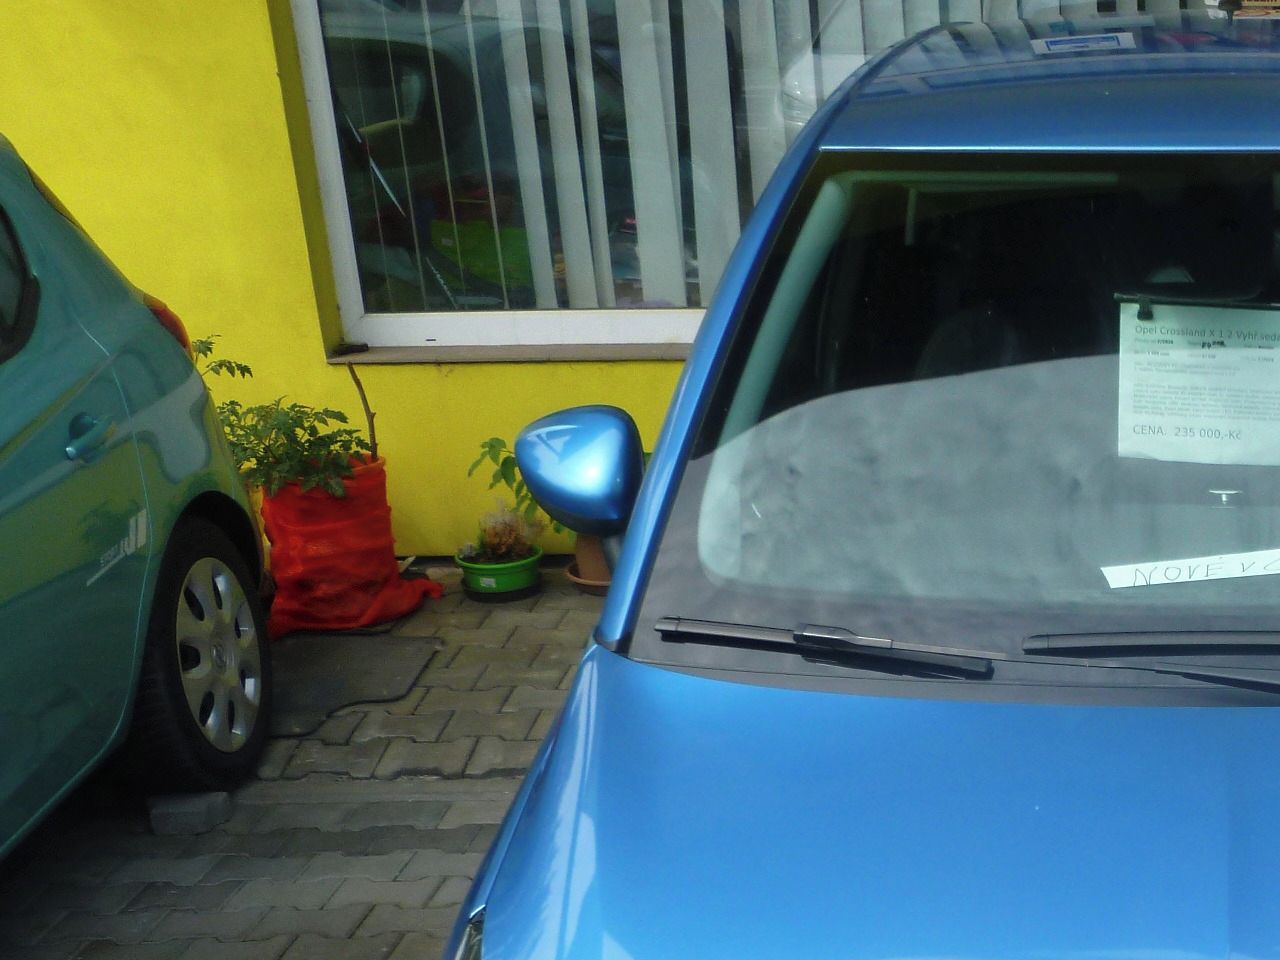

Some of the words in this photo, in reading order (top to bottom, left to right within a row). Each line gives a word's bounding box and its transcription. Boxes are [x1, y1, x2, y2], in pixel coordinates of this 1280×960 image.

[1135, 325, 1157, 336] Opel
[1160, 326, 1206, 337] Crossland
[1209, 329, 1215, 337] X
[1174, 426, 1195, 438] 235
[1133, 556, 1224, 586] NOVÉ
